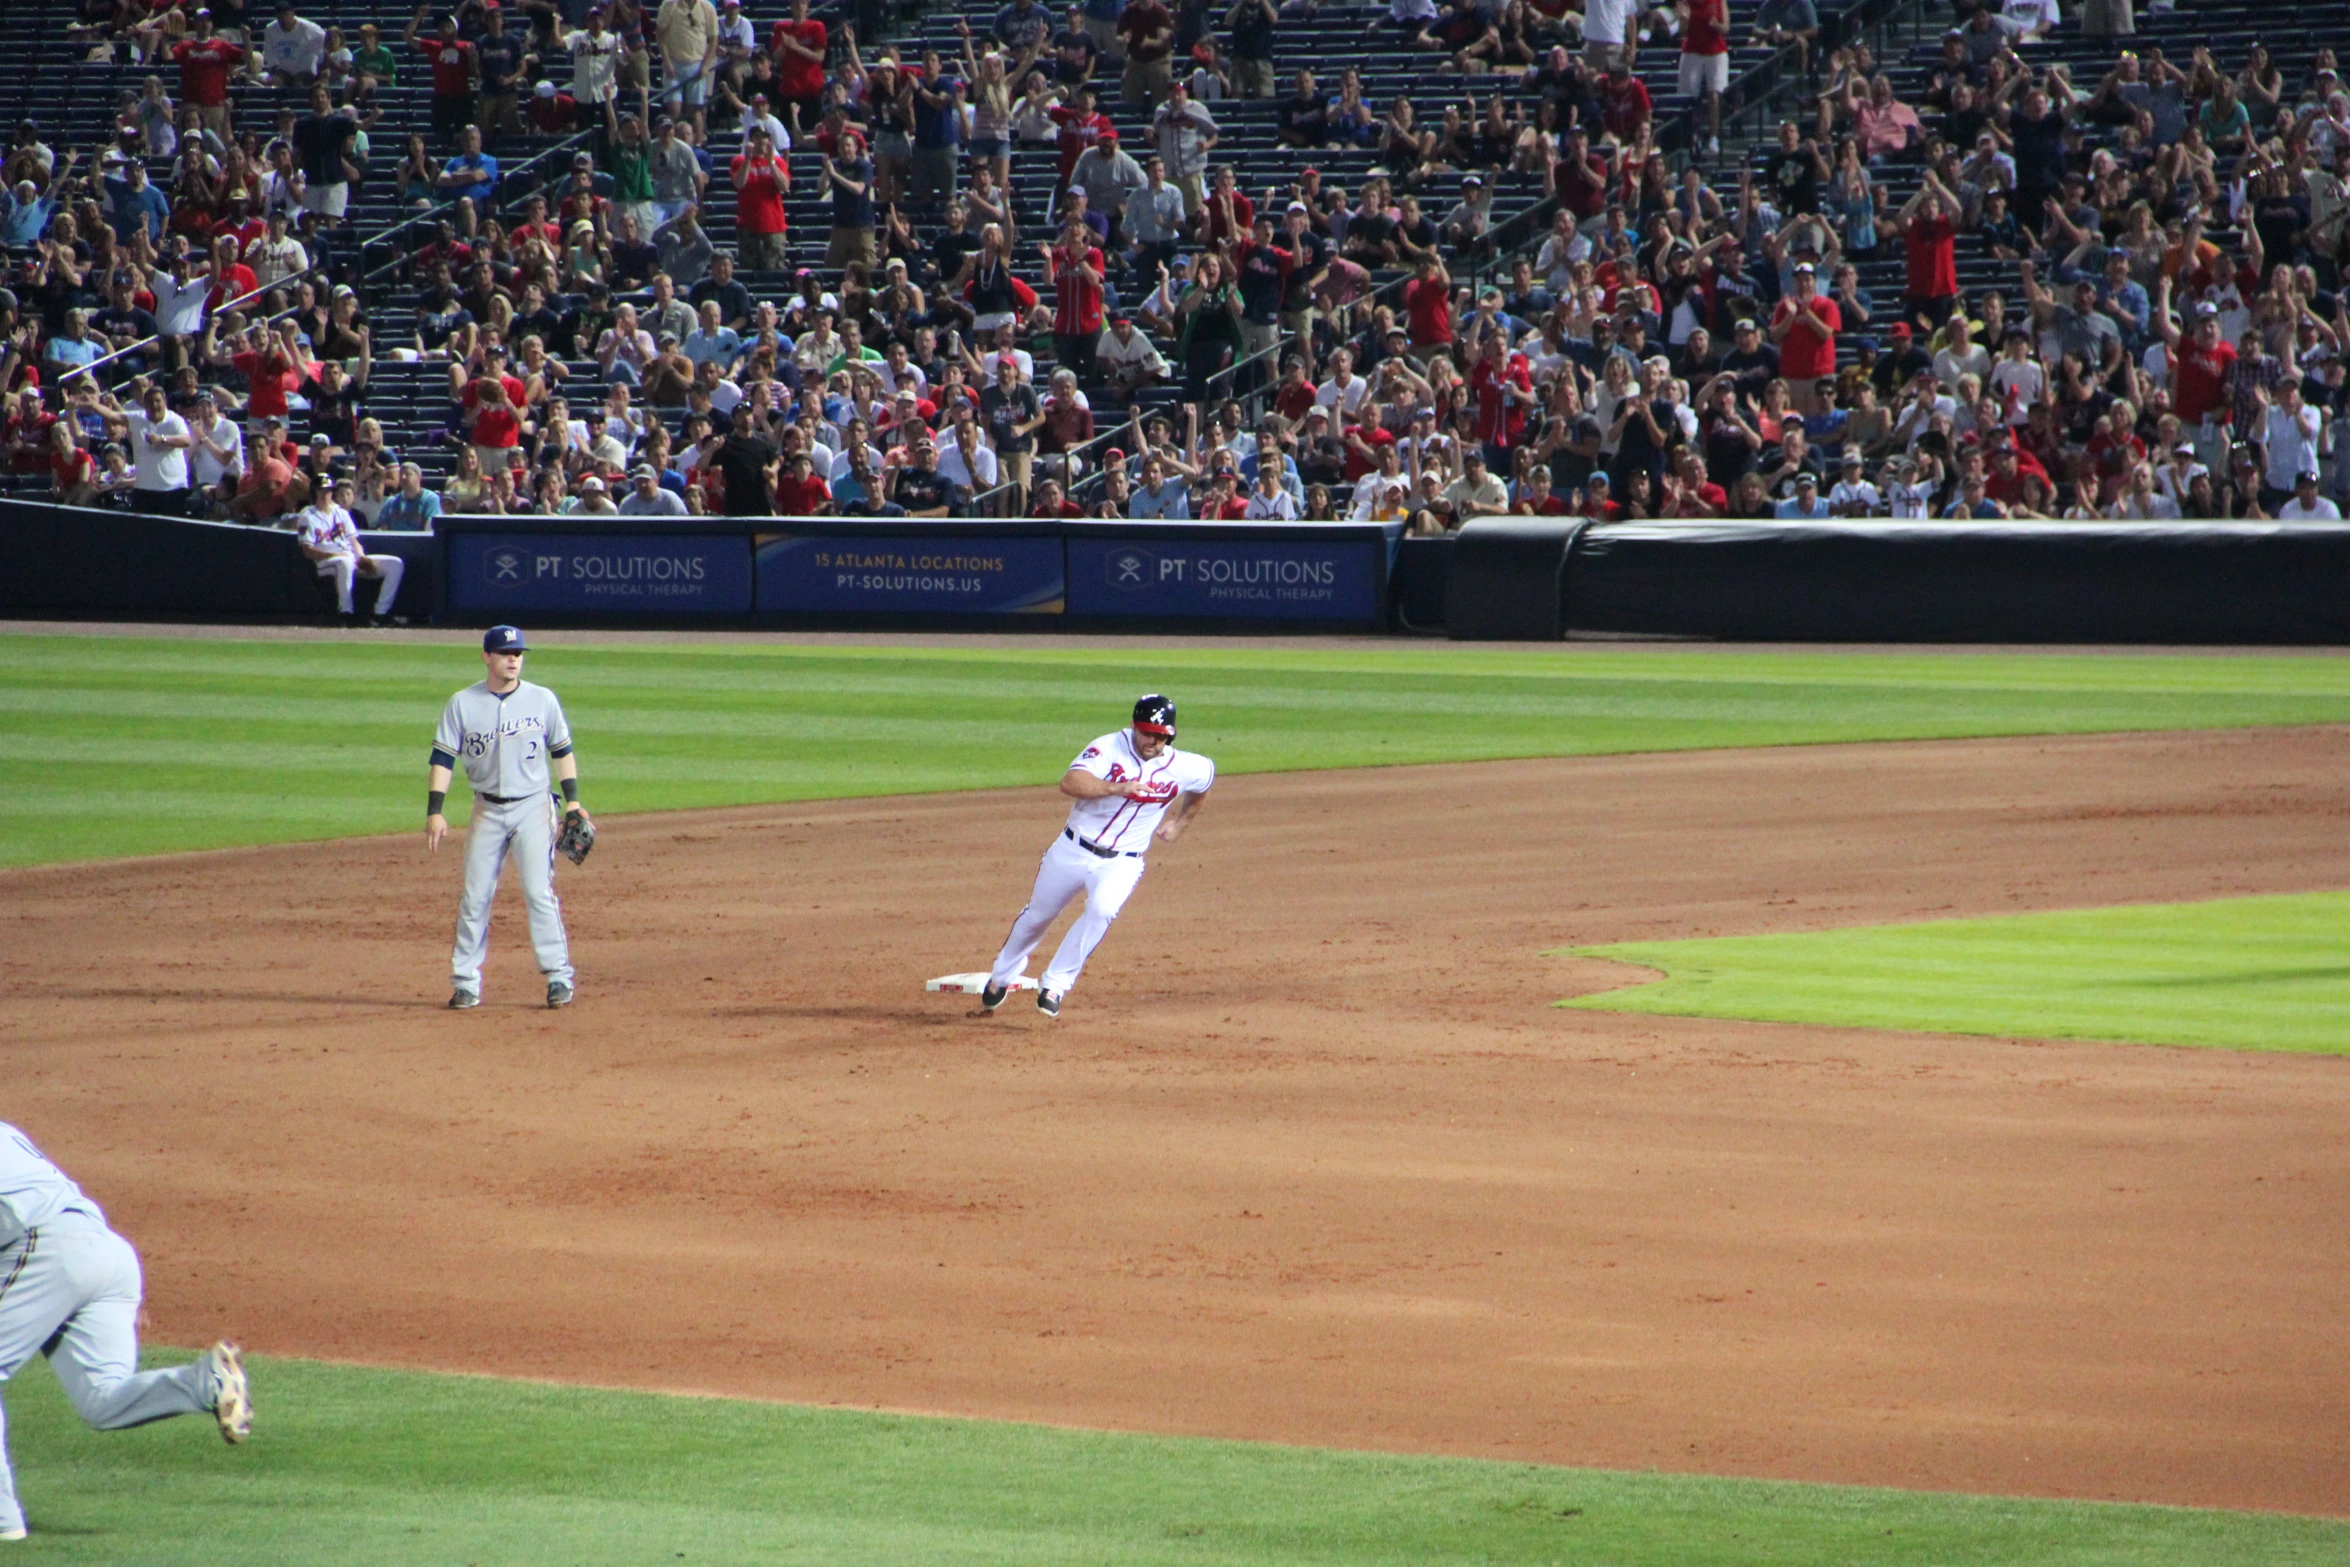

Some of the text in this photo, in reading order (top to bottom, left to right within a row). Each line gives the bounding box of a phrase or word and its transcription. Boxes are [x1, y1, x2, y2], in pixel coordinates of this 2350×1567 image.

[535, 556, 705, 579] PT SOLUTIONS
[815, 554, 1004, 571] 15 ATLANTA LOCATIONS
[1159, 558, 1335, 584] PT SOLUTIONS
[585, 583, 704, 596] PHYSICAL THERAPY
[837, 574, 982, 592] PT-SOLUTIONS.US
[1210, 587, 1334, 601] PHYSICAL THERAPY
[464, 716, 544, 758] Brewers
[524, 740, 538, 760] 2
